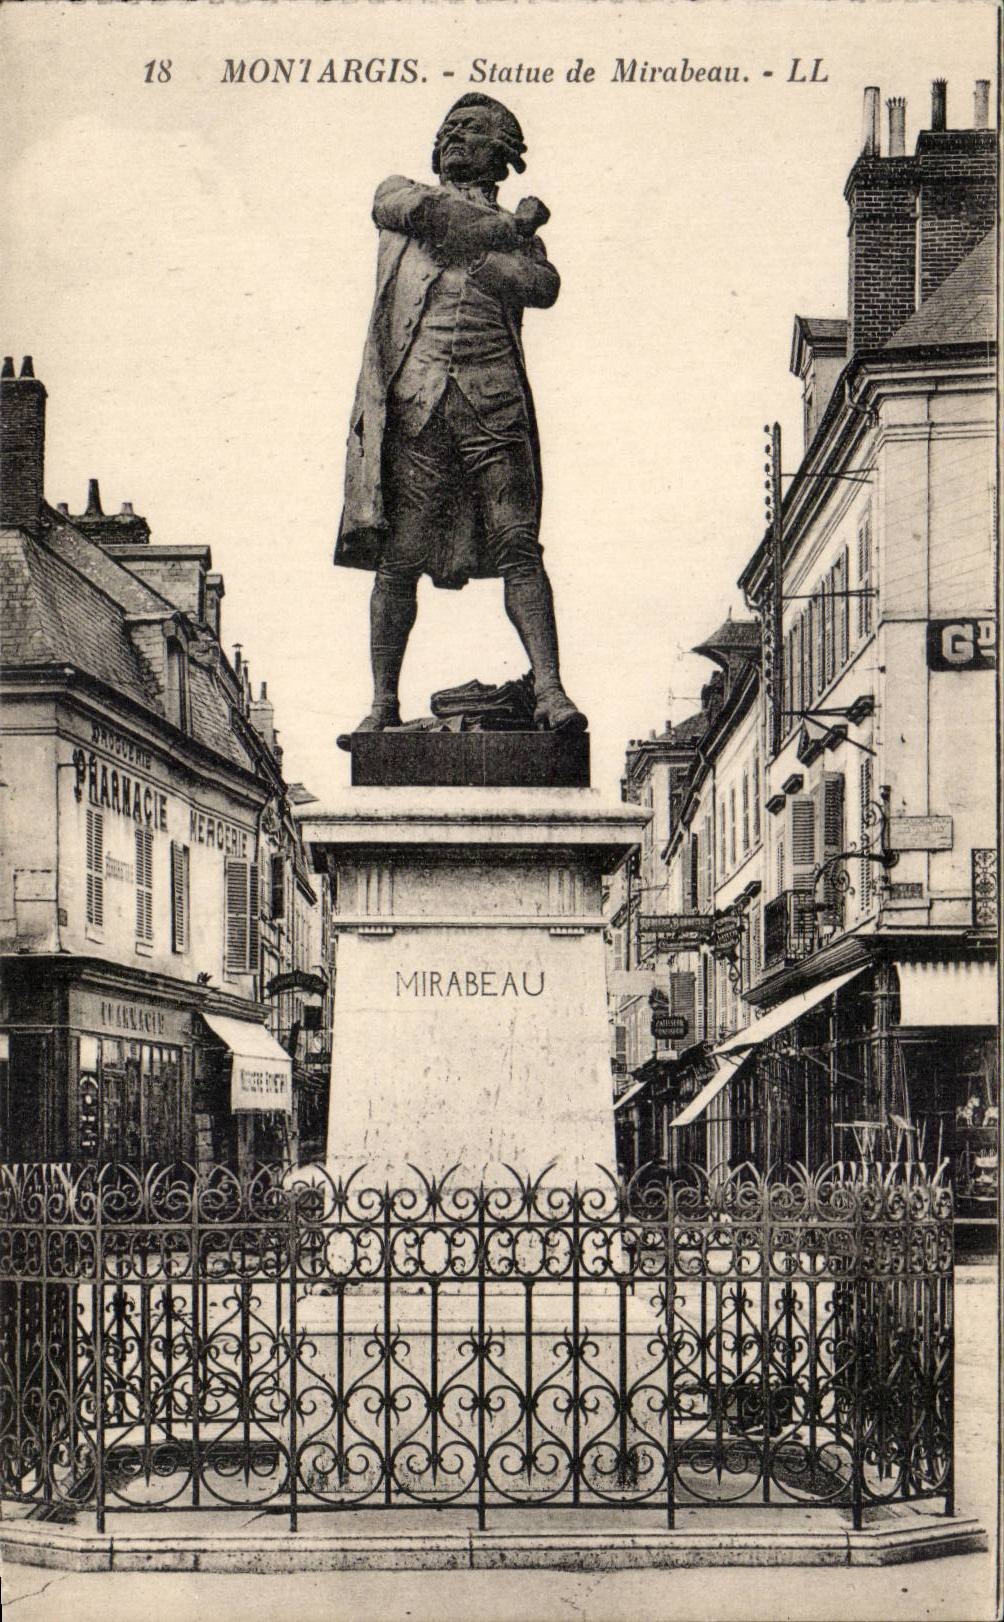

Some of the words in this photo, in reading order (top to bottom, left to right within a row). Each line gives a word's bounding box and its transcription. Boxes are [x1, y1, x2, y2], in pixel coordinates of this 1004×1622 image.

[73, 748, 168, 833] PHARMACIE
[189, 809, 248, 859] MERCERIE
[395, 970, 546, 998] MIRABEAU
